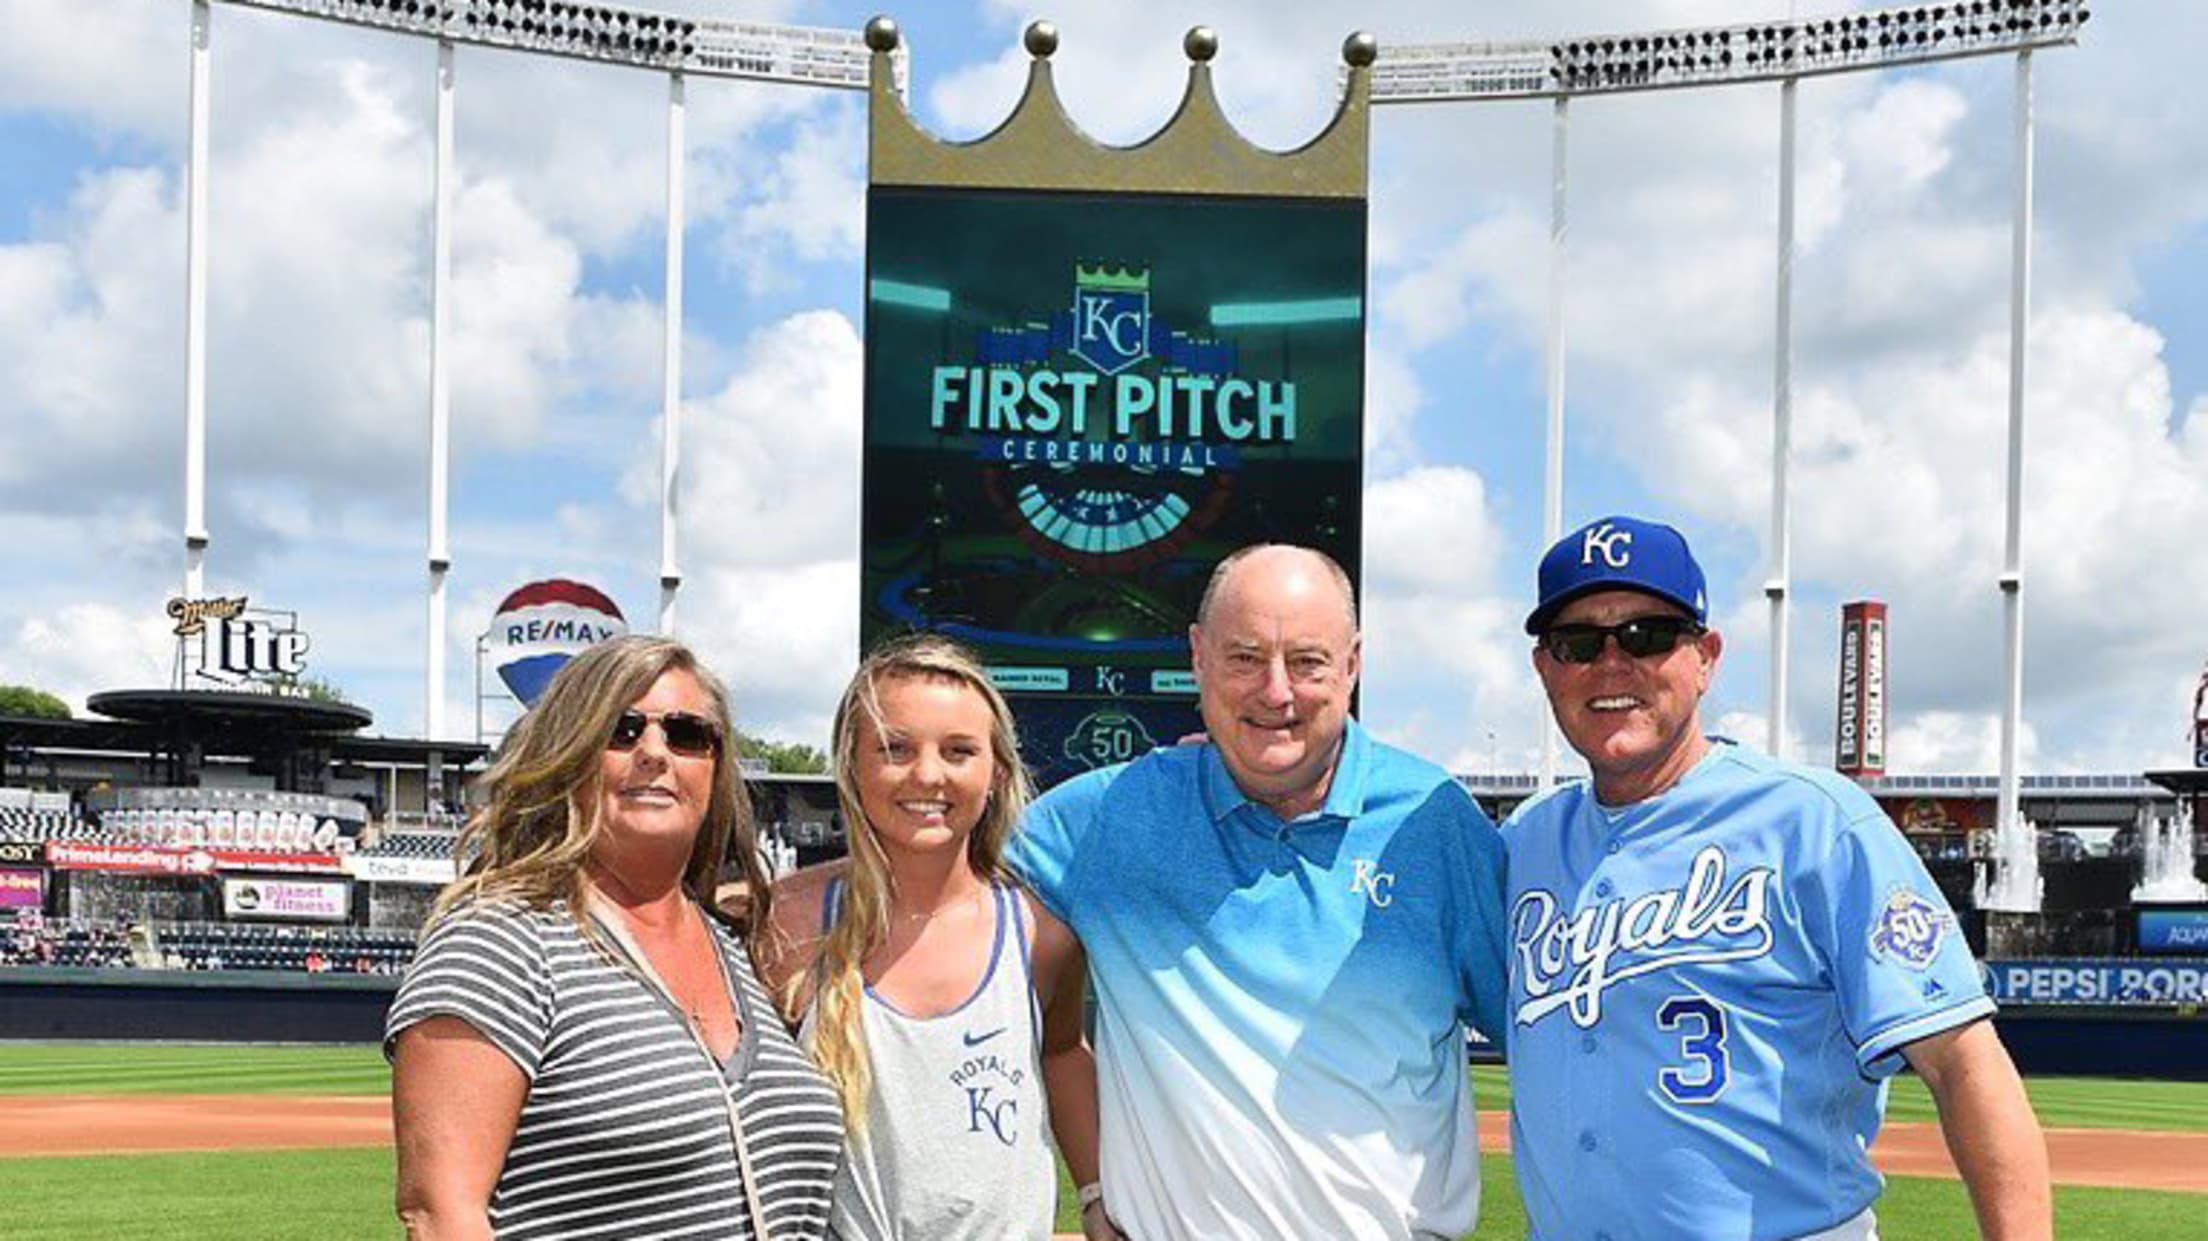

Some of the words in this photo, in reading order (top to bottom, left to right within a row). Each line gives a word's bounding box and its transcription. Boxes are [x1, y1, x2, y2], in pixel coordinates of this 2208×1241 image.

[1082, 296, 1142, 356] KC
[931, 366, 1098, 433] FIRST
[1115, 375, 1296, 440] PITCH
[1002, 440, 1217, 467] CEREMONIAL
[1582, 524, 1632, 567] KC
[167, 597, 248, 635] Miller
[198, 617, 310, 686] Lite
[1096, 666, 1125, 697] KC
[1841, 631, 1858, 754] BOULEVARD
[1092, 728, 1133, 759] 50
[264, 885, 325, 901] planet
[1349, 857, 1395, 908] KC
[273, 899, 336, 912] fitness
[1514, 845, 1775, 1029] Royals
[1890, 906, 1931, 948] 50
[2007, 969, 2107, 998] PEPSI
[2121, 969, 2208, 1001] POR
[1658, 996, 1729, 1103] 3
[950, 1055, 1024, 1087] ROYALS
[965, 1087, 1018, 1146] KC
